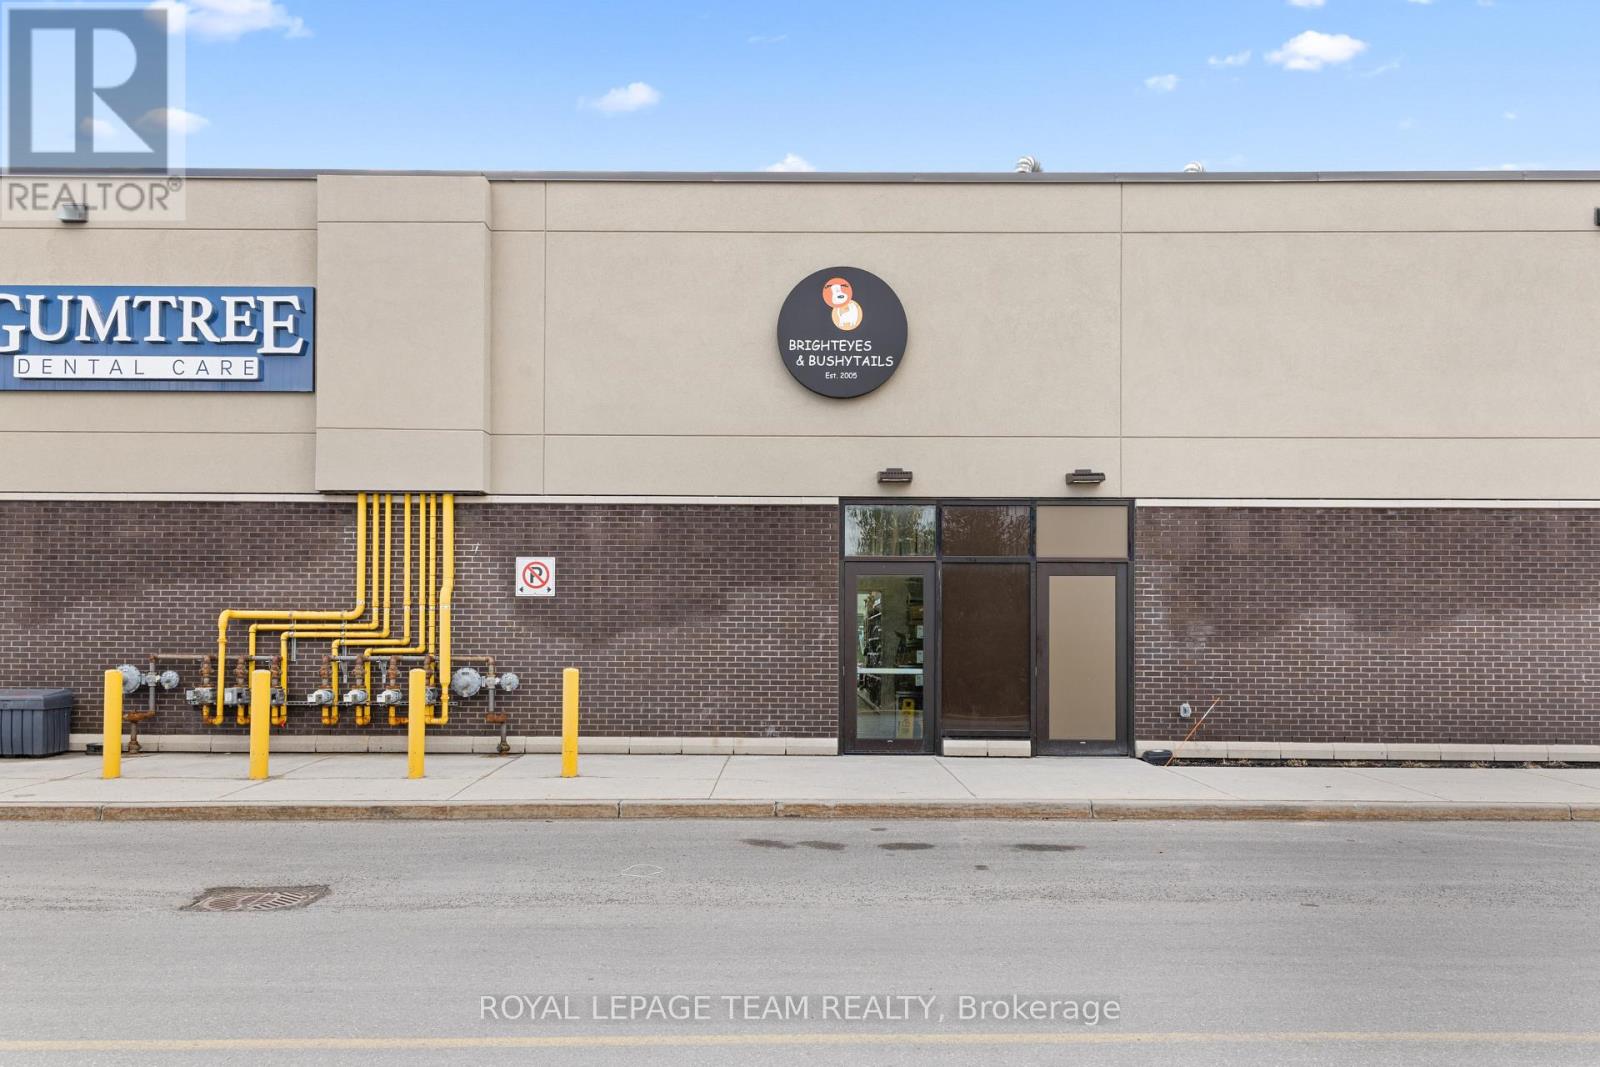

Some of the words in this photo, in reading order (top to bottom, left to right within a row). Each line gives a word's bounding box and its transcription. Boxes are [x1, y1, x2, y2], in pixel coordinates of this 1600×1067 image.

[788, 339, 872, 352] BRIGHTEYES
[17, 358, 145, 375] DENTAL
[172, 359, 256, 376] CARE
[796, 354, 805, 367] &
[808, 355, 894, 367] BUSHYTAILS
[825, 371, 839, 380] Est.
[840, 371, 858, 380] 2005
